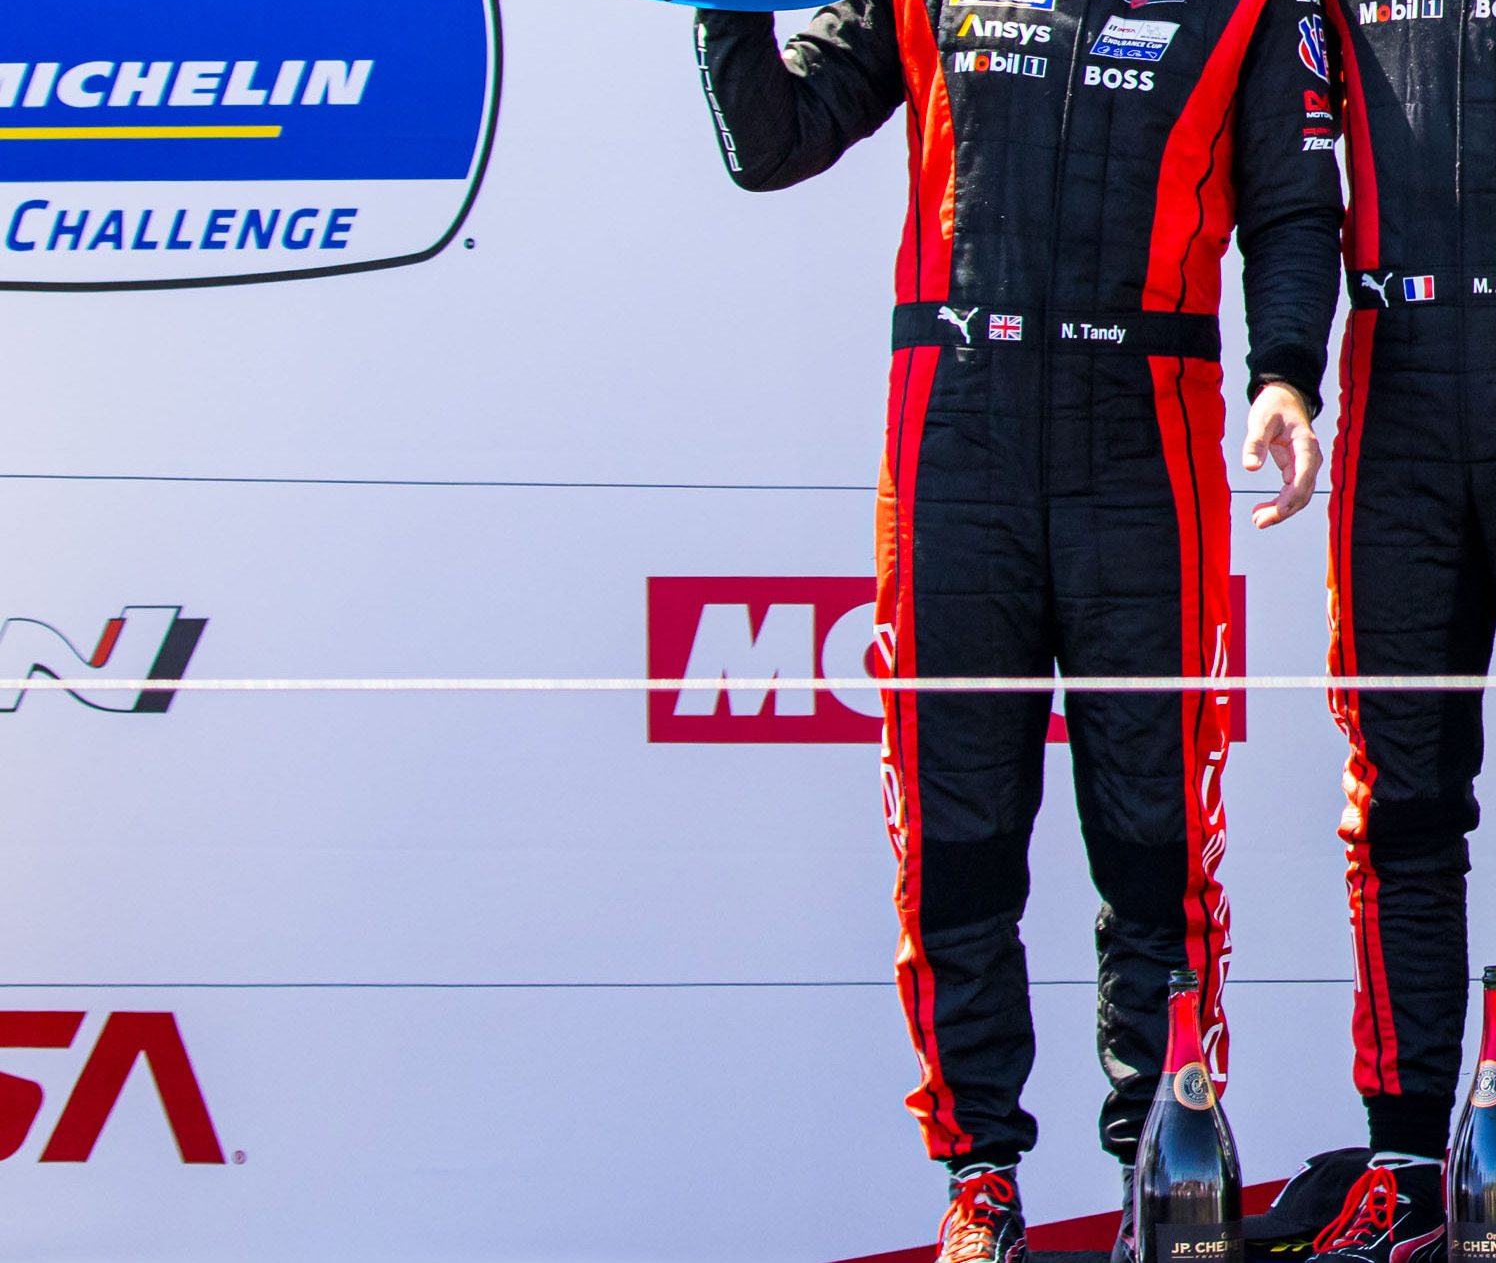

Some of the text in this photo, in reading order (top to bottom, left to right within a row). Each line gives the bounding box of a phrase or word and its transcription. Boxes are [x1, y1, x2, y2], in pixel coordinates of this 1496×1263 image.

[957, 13, 1052, 45] Ansys
[954, 51, 1021, 74] Mobil
[1083, 65, 1155, 91] BOSS
[1473, 278, 1492, 294] M.
[1061, 323, 1126, 344] N. Tandy
[1171, 1243, 1191, 1253] JP.
